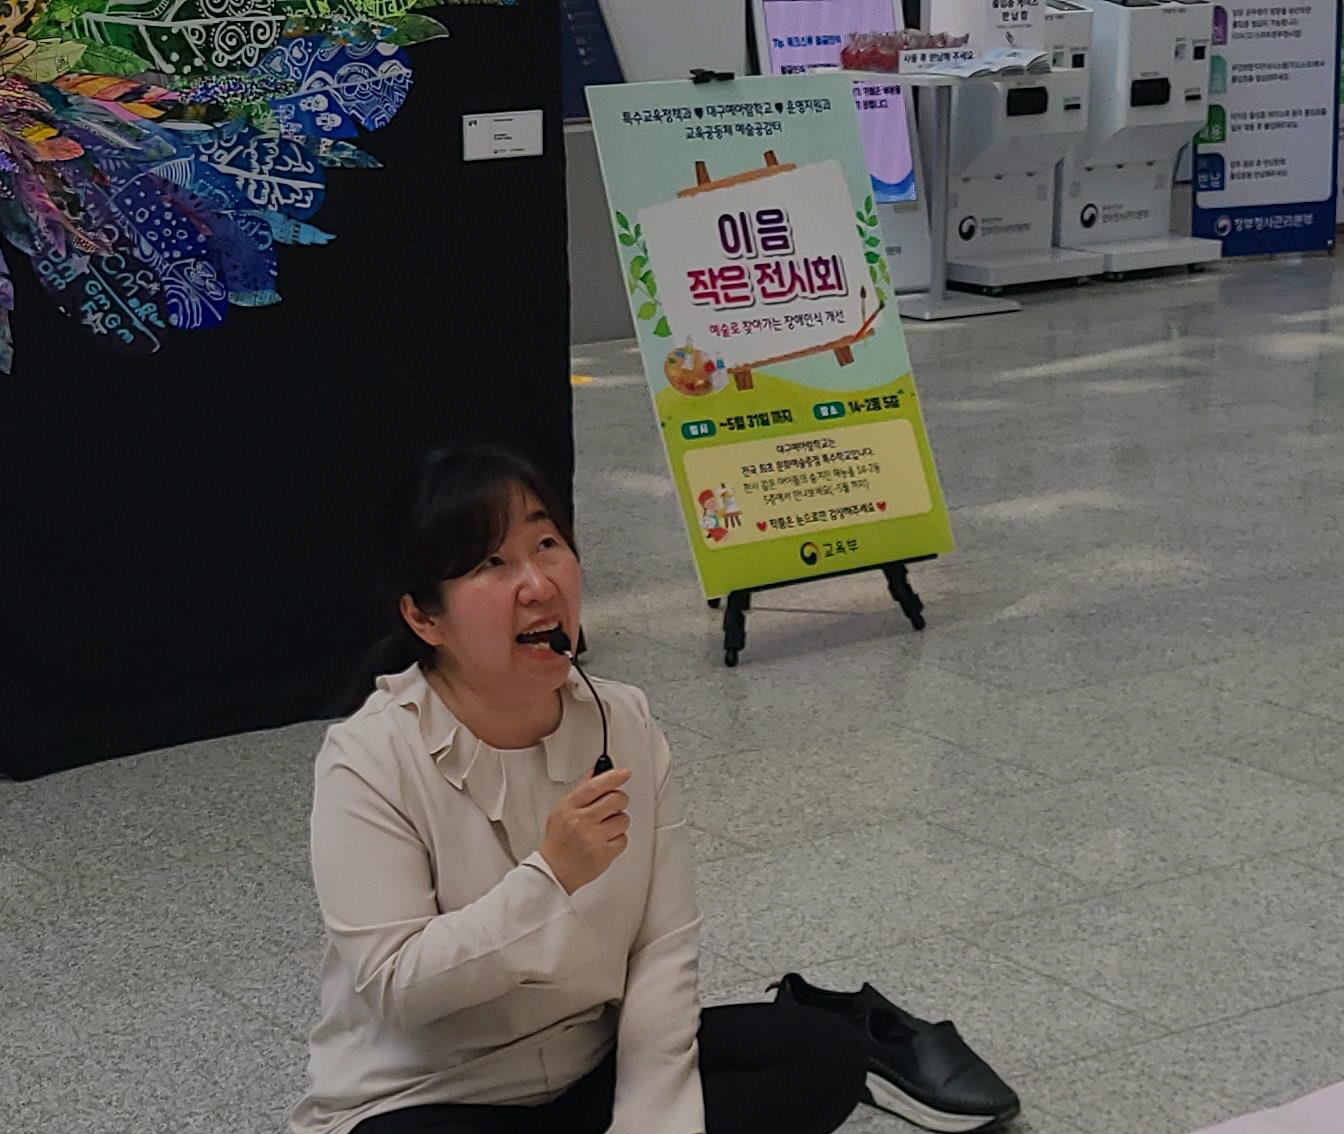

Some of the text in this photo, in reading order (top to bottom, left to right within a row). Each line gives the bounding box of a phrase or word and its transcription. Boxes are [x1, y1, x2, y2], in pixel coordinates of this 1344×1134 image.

[686, 124, 733, 140] 교육공동체
[717, 208, 792, 254] 이음
[687, 254, 846, 305] 작은 전시회
[709, 310, 846, 337] 예술로 찾아가는 장애인식 개선
[822, 539, 859, 558] 교육부
